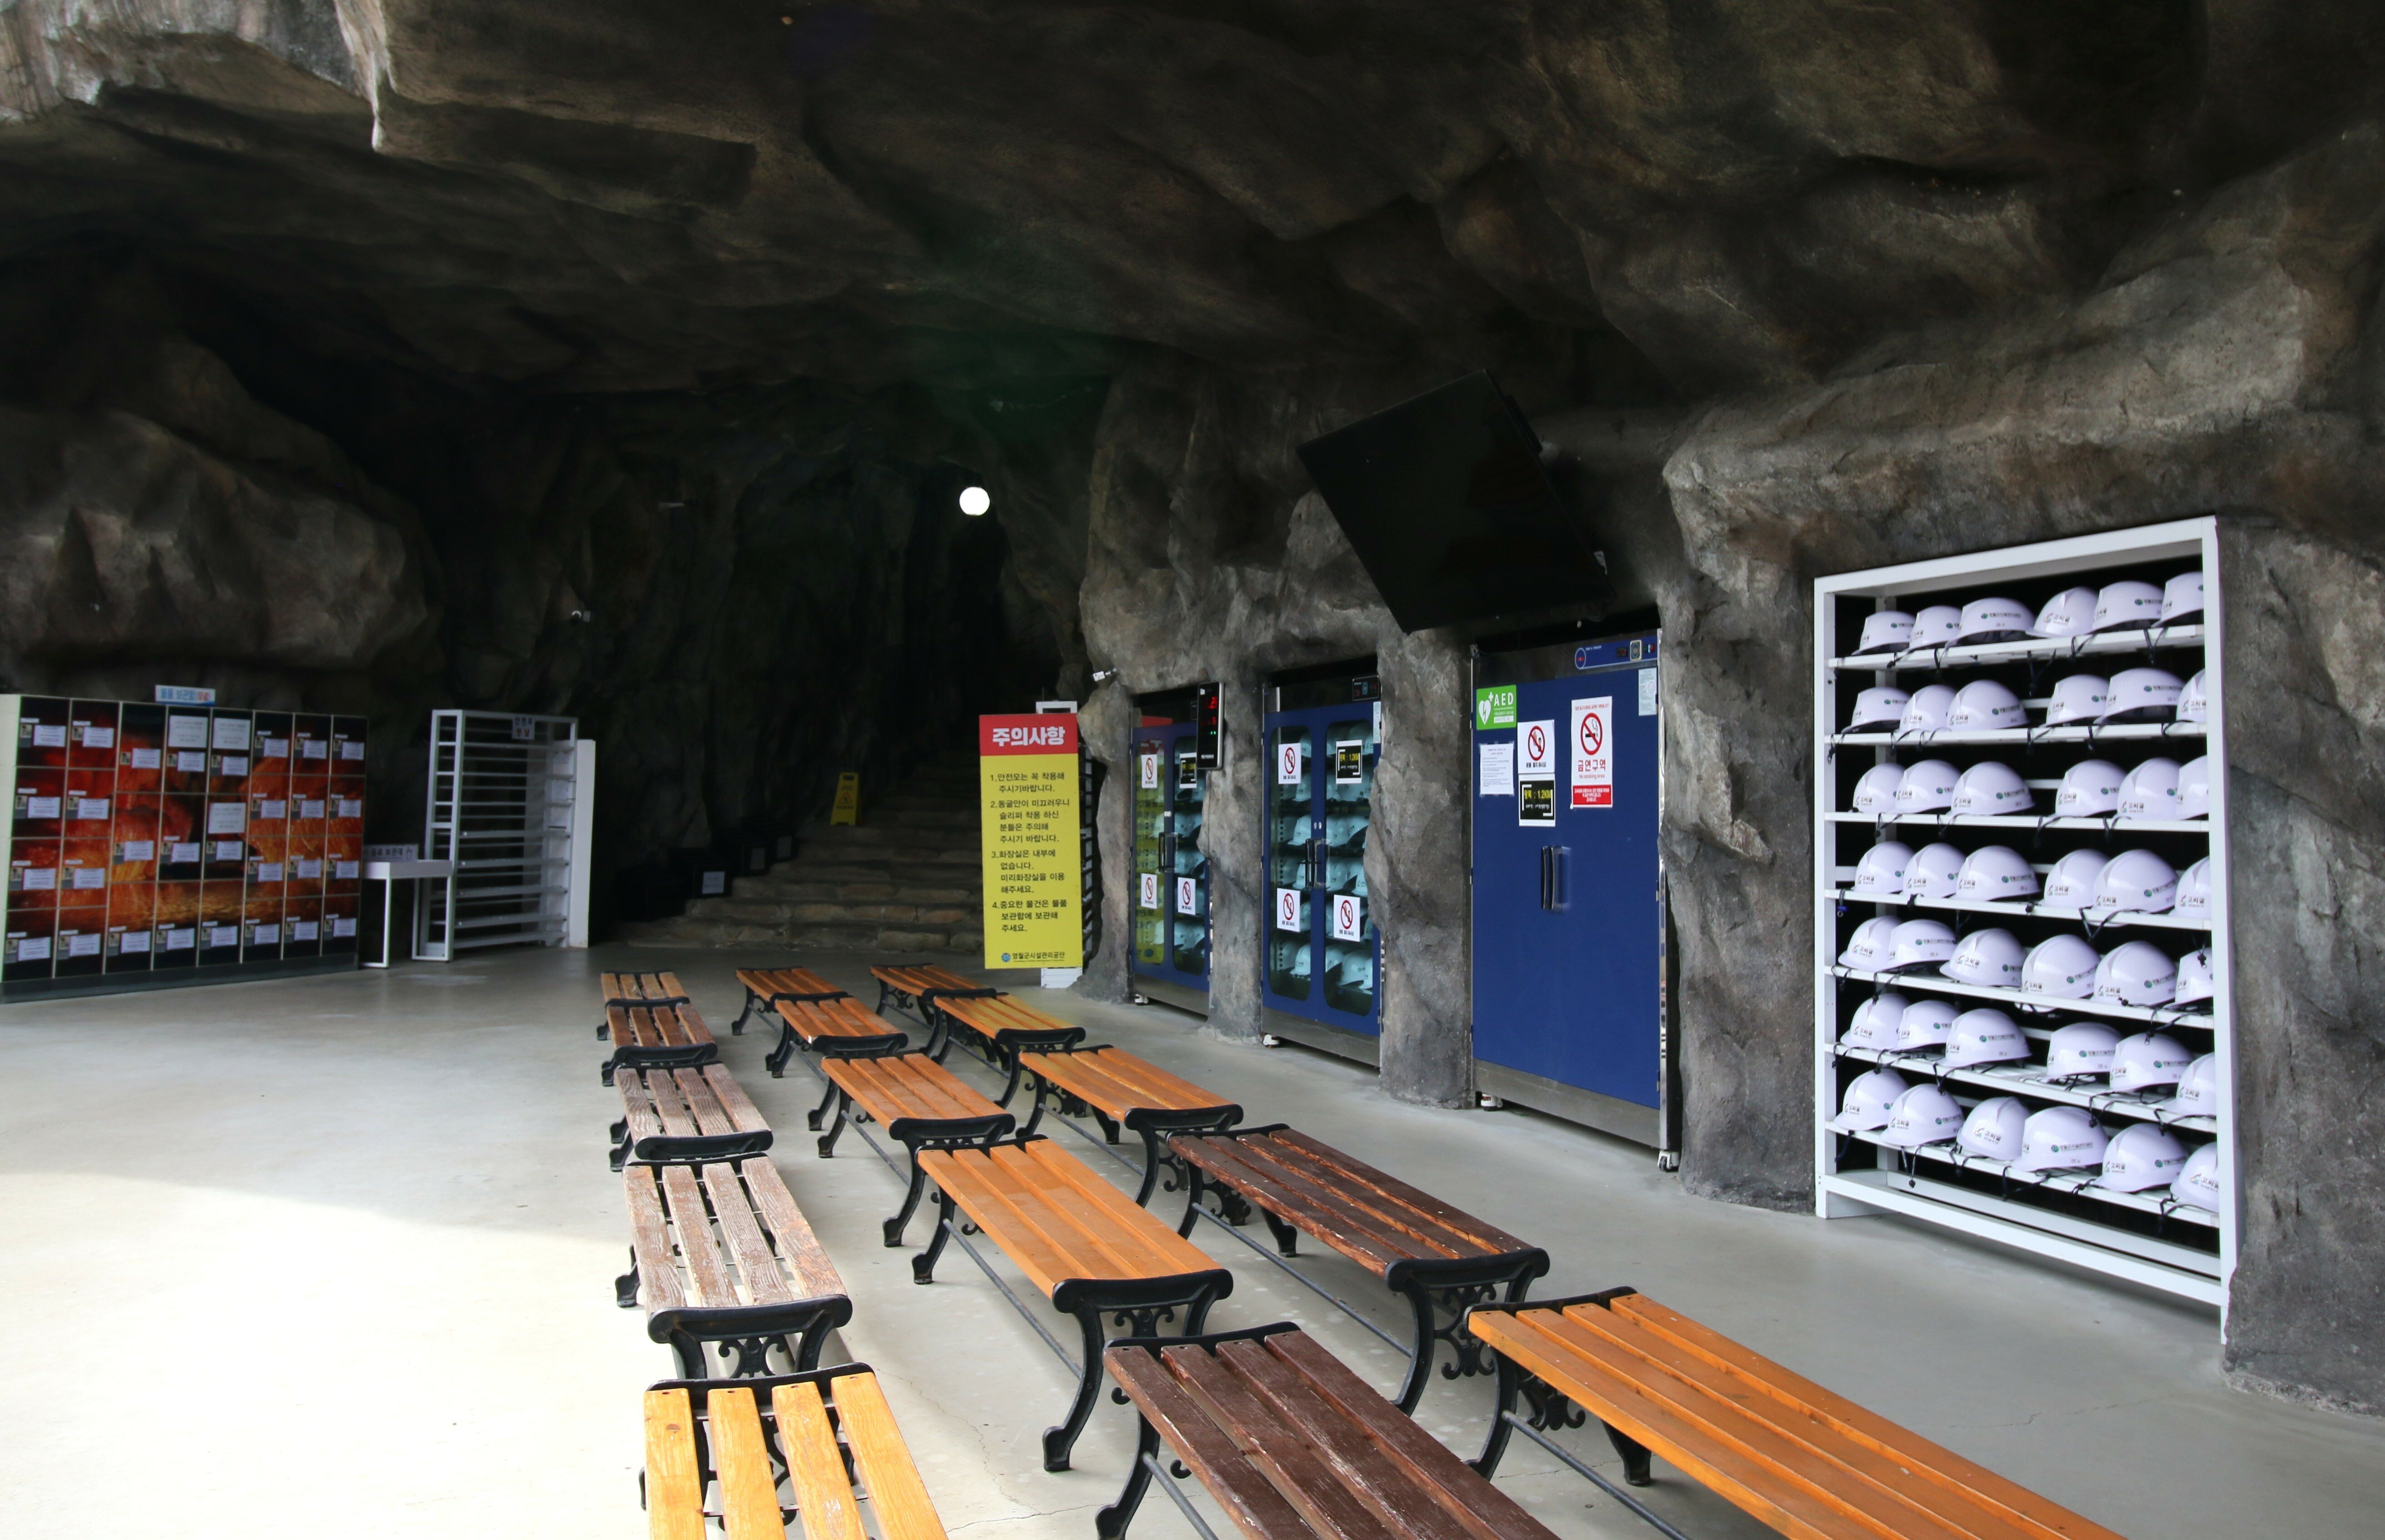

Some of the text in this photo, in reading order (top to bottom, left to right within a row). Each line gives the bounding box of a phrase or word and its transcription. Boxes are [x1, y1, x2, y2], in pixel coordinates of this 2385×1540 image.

[1494, 692, 1513, 707] AED
[993, 727, 1065, 747] 주의사항
[1578, 758, 1606, 772] 금연구역
[1538, 789, 1551, 799] 1.2KM
[1026, 822, 1049, 831] 주의해
[1000, 835, 1023, 843] 주시기
[992, 850, 1029, 858] 3.화장실은
[1000, 862, 1033, 870] 없습니다.
[1001, 885, 1034, 893] 해주세요.
[993, 900, 1023, 909] 4.중요한
[1013, 952, 1065, 960] 영월군시설관리공단
